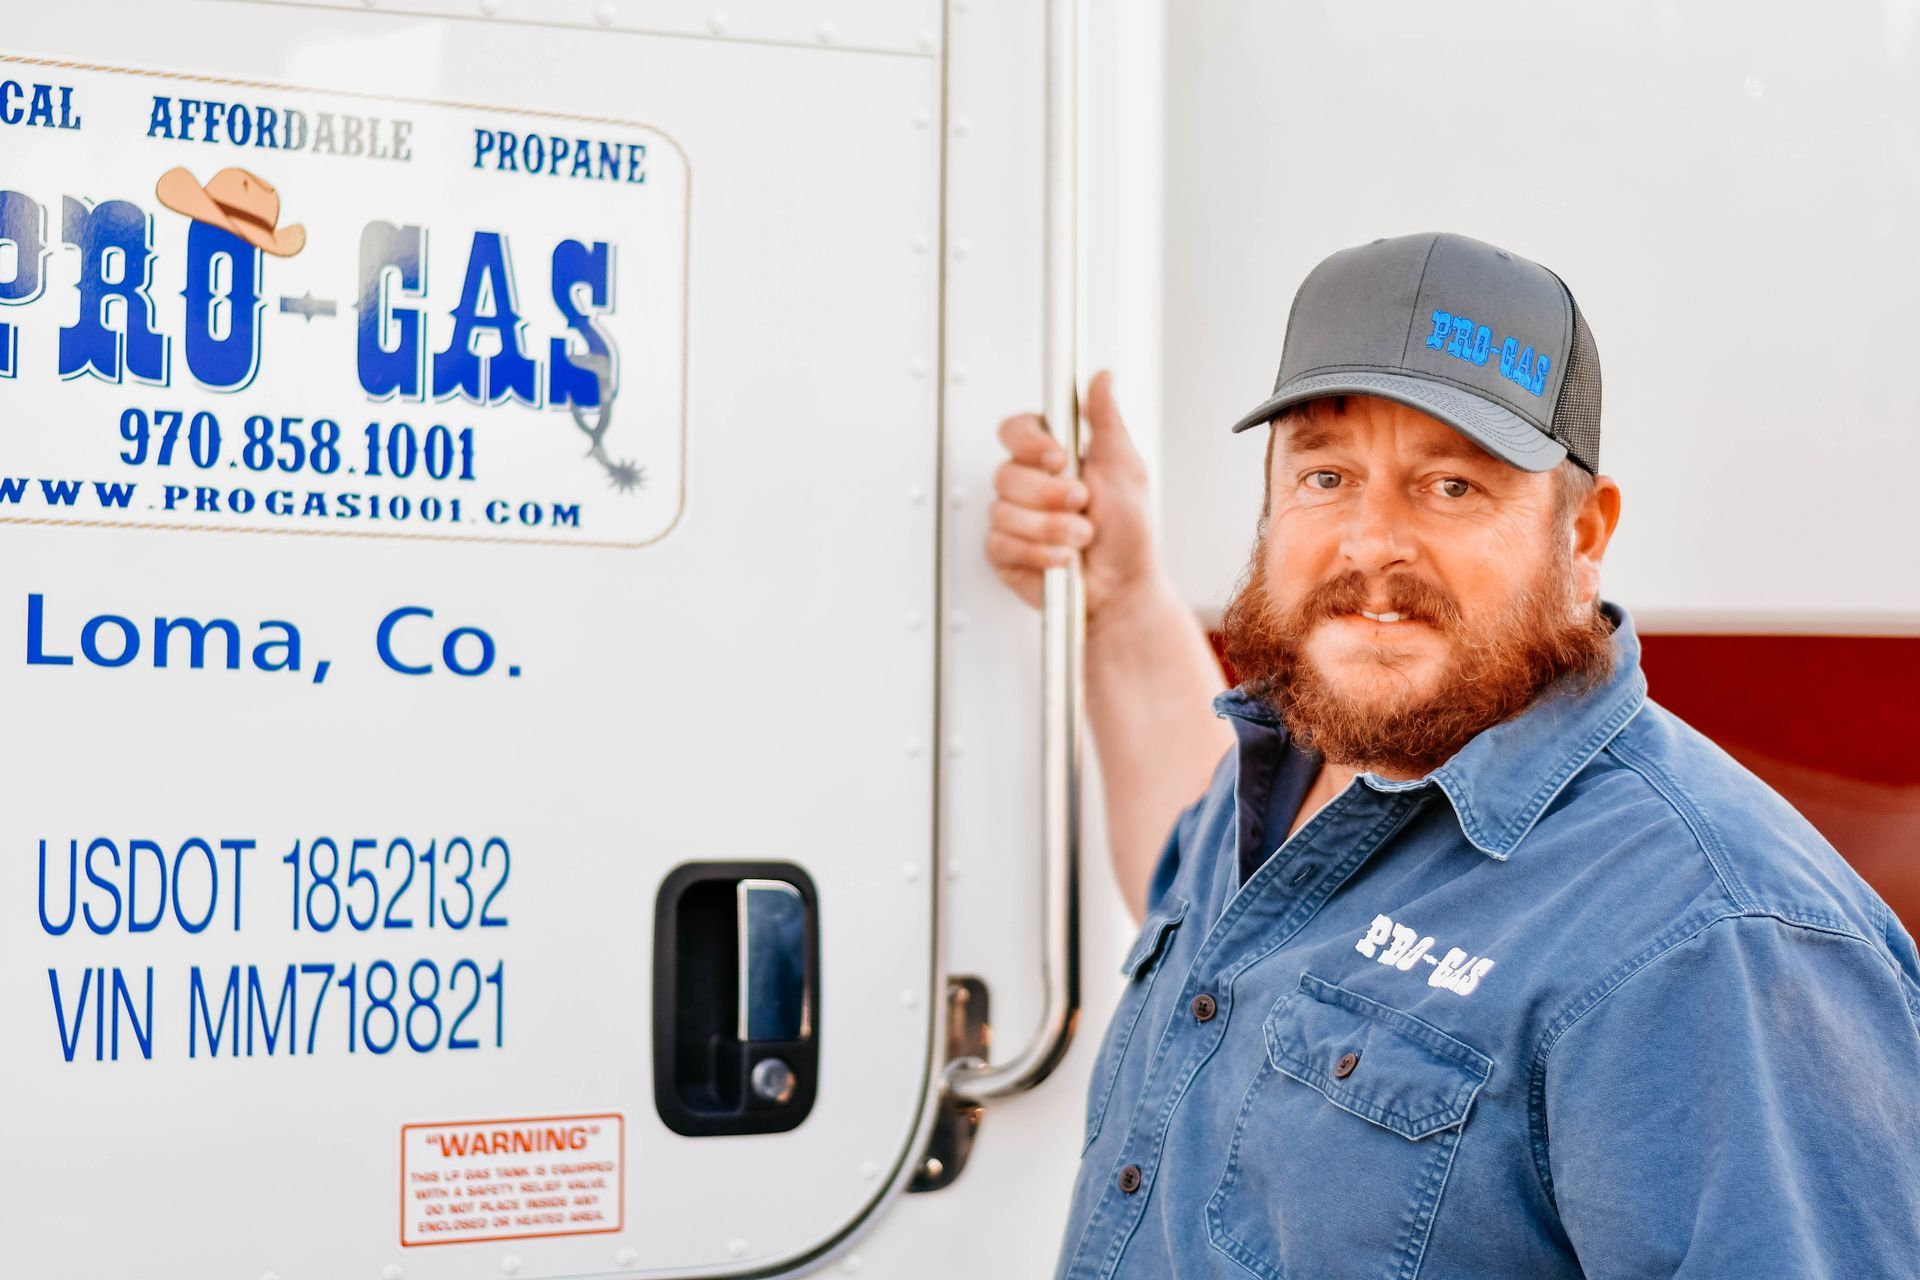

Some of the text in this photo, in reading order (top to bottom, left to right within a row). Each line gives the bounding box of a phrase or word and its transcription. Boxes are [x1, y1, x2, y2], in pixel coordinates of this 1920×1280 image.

[146, 96, 412, 161] AFFORDABLE
[474, 128, 646, 184] PROPANE
[1426, 309, 1551, 397] PRO-GAS
[119, 408, 477, 481] 970.858.1001
[26, 593, 522, 684] Loma, Co.
[38, 836, 511, 936] USDOT 1852132
[1355, 913, 1495, 996] PRO-GAS
[48, 958, 503, 1062] VIN MM718821
